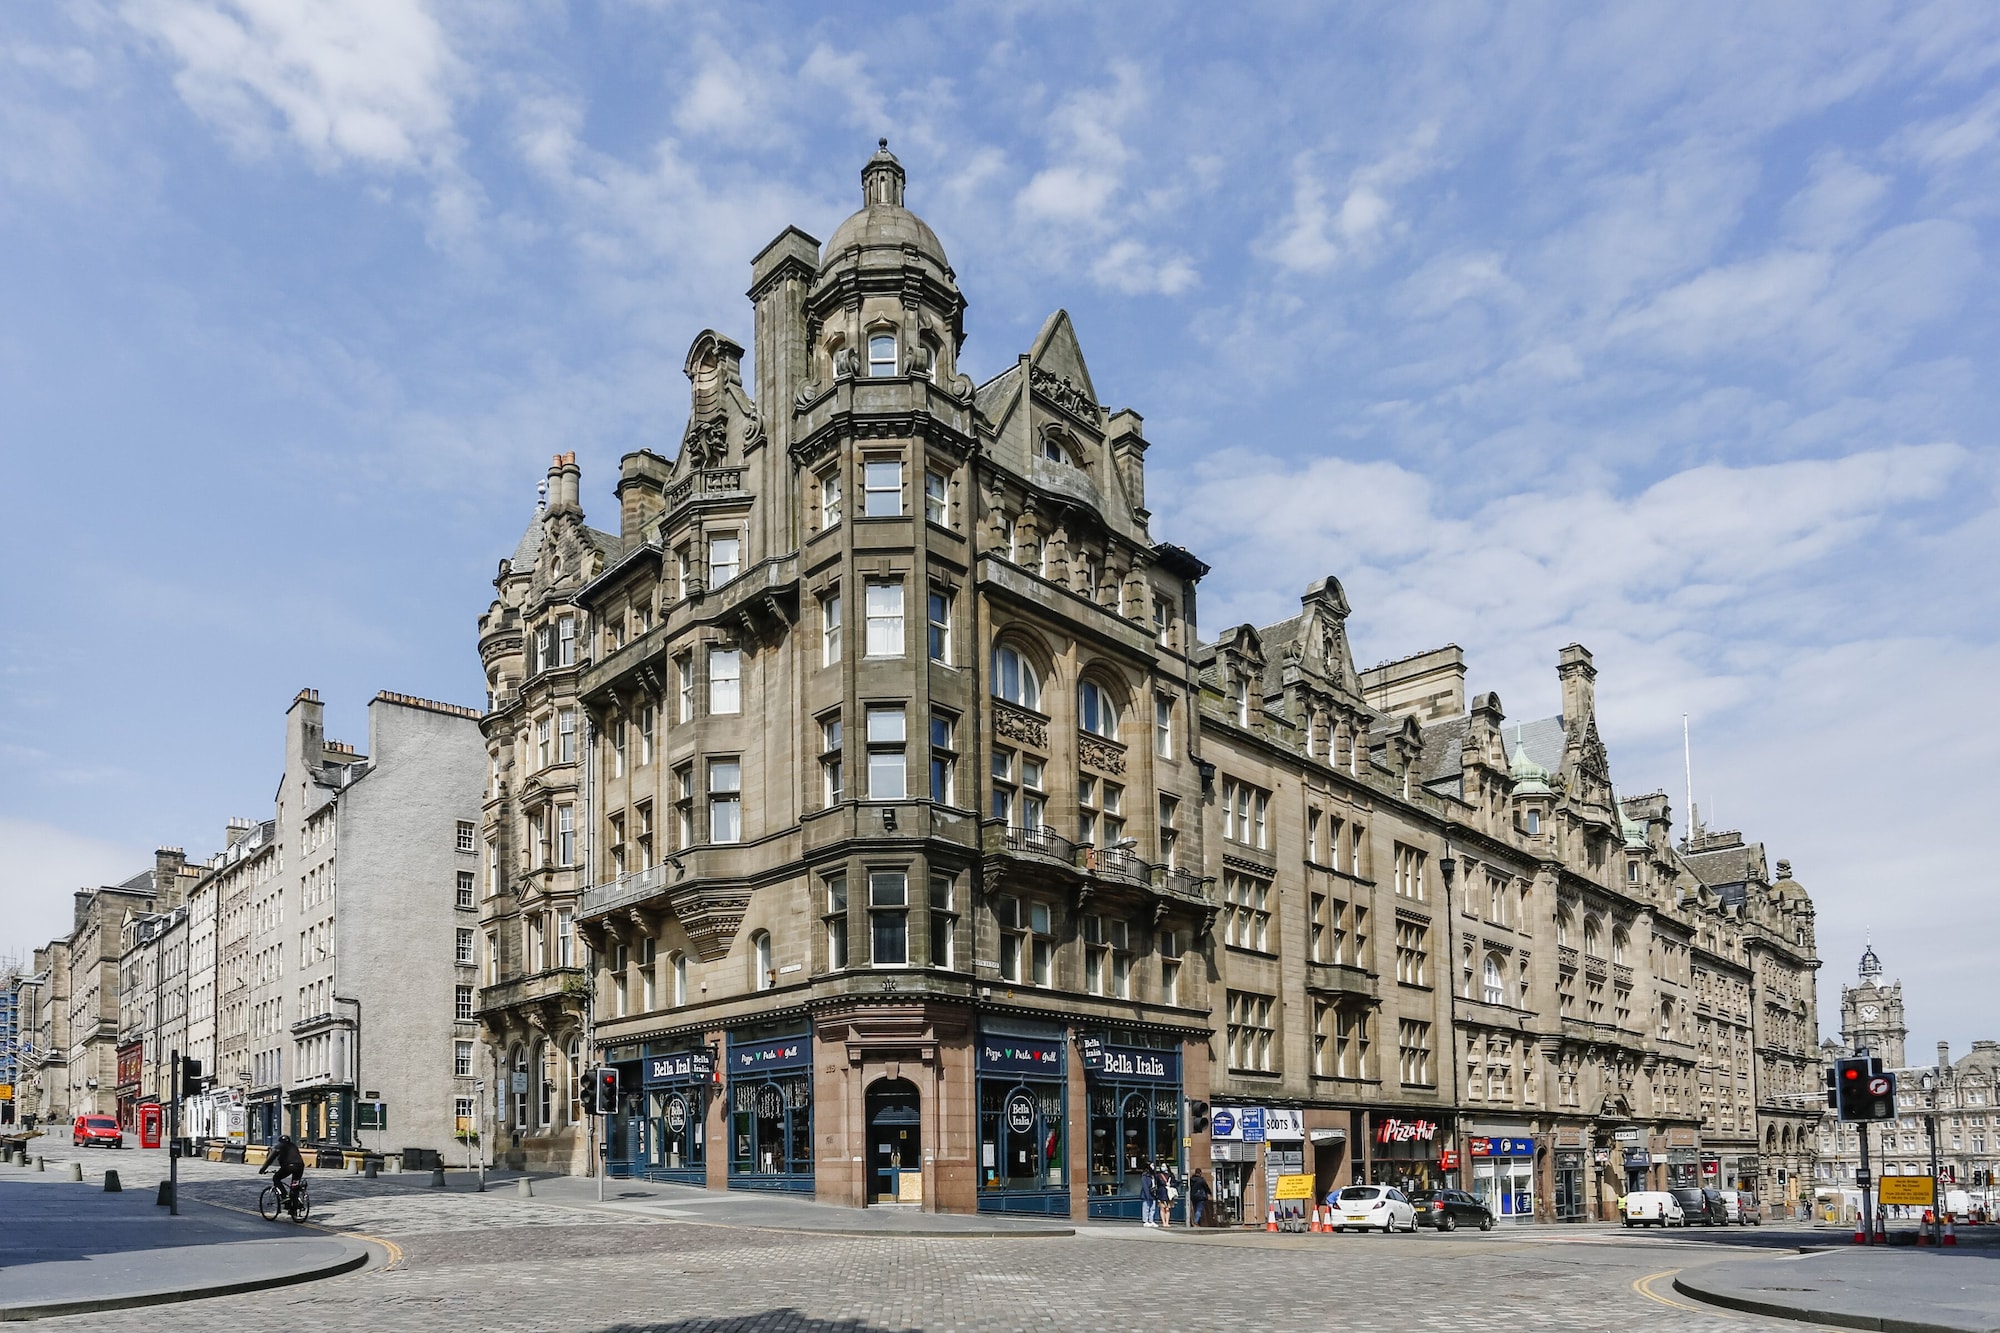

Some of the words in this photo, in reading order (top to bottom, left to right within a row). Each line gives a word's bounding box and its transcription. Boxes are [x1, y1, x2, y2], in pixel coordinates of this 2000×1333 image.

[1084, 1038, 1100, 1048] Bella
[763, 1050, 776, 1060] Pasta
[784, 1046, 798, 1059] Grill
[986, 1046, 1002, 1062] Pizza
[1015, 1049, 1032, 1060] Pasta
[1042, 1052, 1056, 1063] Grill
[1086, 1049, 1102, 1057] Italia
[693, 1054, 709, 1063] Bella
[653, 1060, 674, 1078] Bella
[675, 1058, 690, 1074] Ital
[693, 1064, 710, 1072] Italia
[1104, 1052, 1133, 1074] Bella
[1136, 1056, 1164, 1076] Italia
[1012, 1104, 1030, 1114] Bella
[1012, 1116, 1030, 1126] Italia
[1266, 1119, 1288, 1130] SCOTS
[1386, 1118, 1416, 1143] Pizza
[1416, 1120, 1438, 1141] Hut
